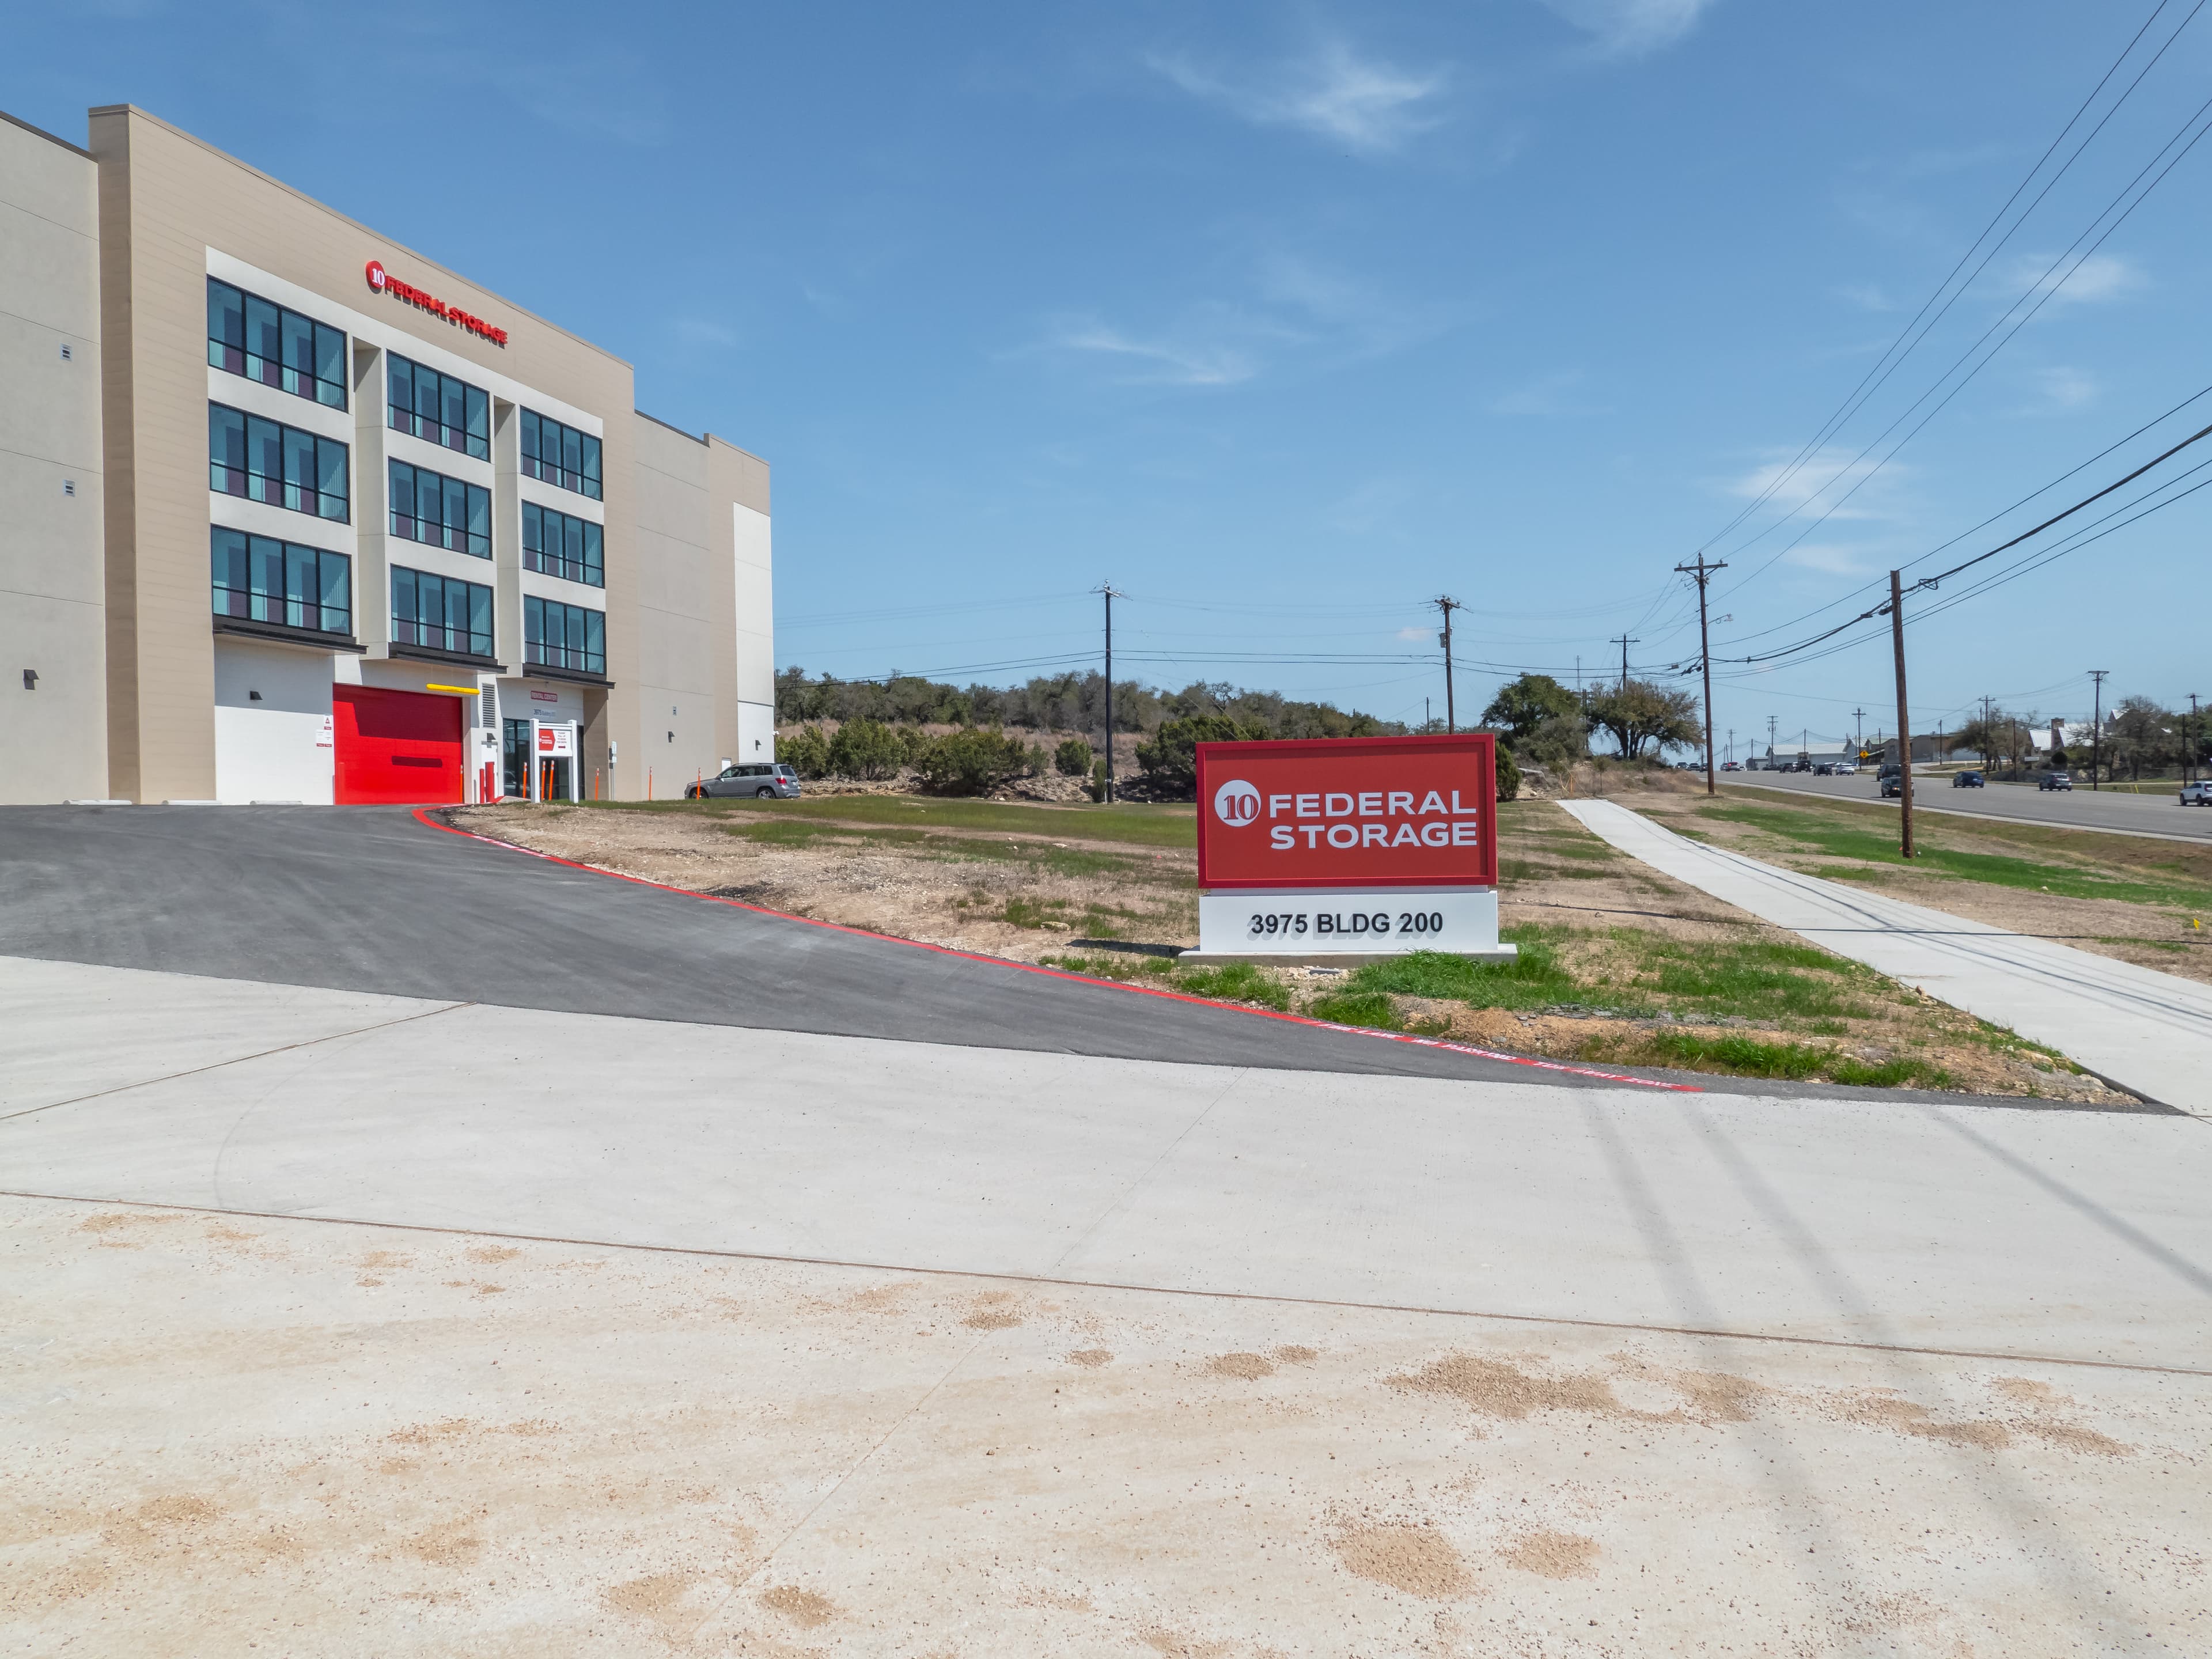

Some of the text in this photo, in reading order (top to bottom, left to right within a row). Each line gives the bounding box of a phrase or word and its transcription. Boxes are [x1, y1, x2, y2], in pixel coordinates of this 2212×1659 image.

[372, 268, 508, 344] 10 FEDERAL STORAGE
[1224, 790, 1477, 821] 10 FEDERAL
[1270, 821, 1478, 850] STORAGE
[1251, 912, 1444, 934] 3975 BLDG 200
[1356, 1029, 1403, 1039] LANE
[1571, 1069, 1624, 1079] AWAY
[1623, 1077, 1681, 1088] ZONE
